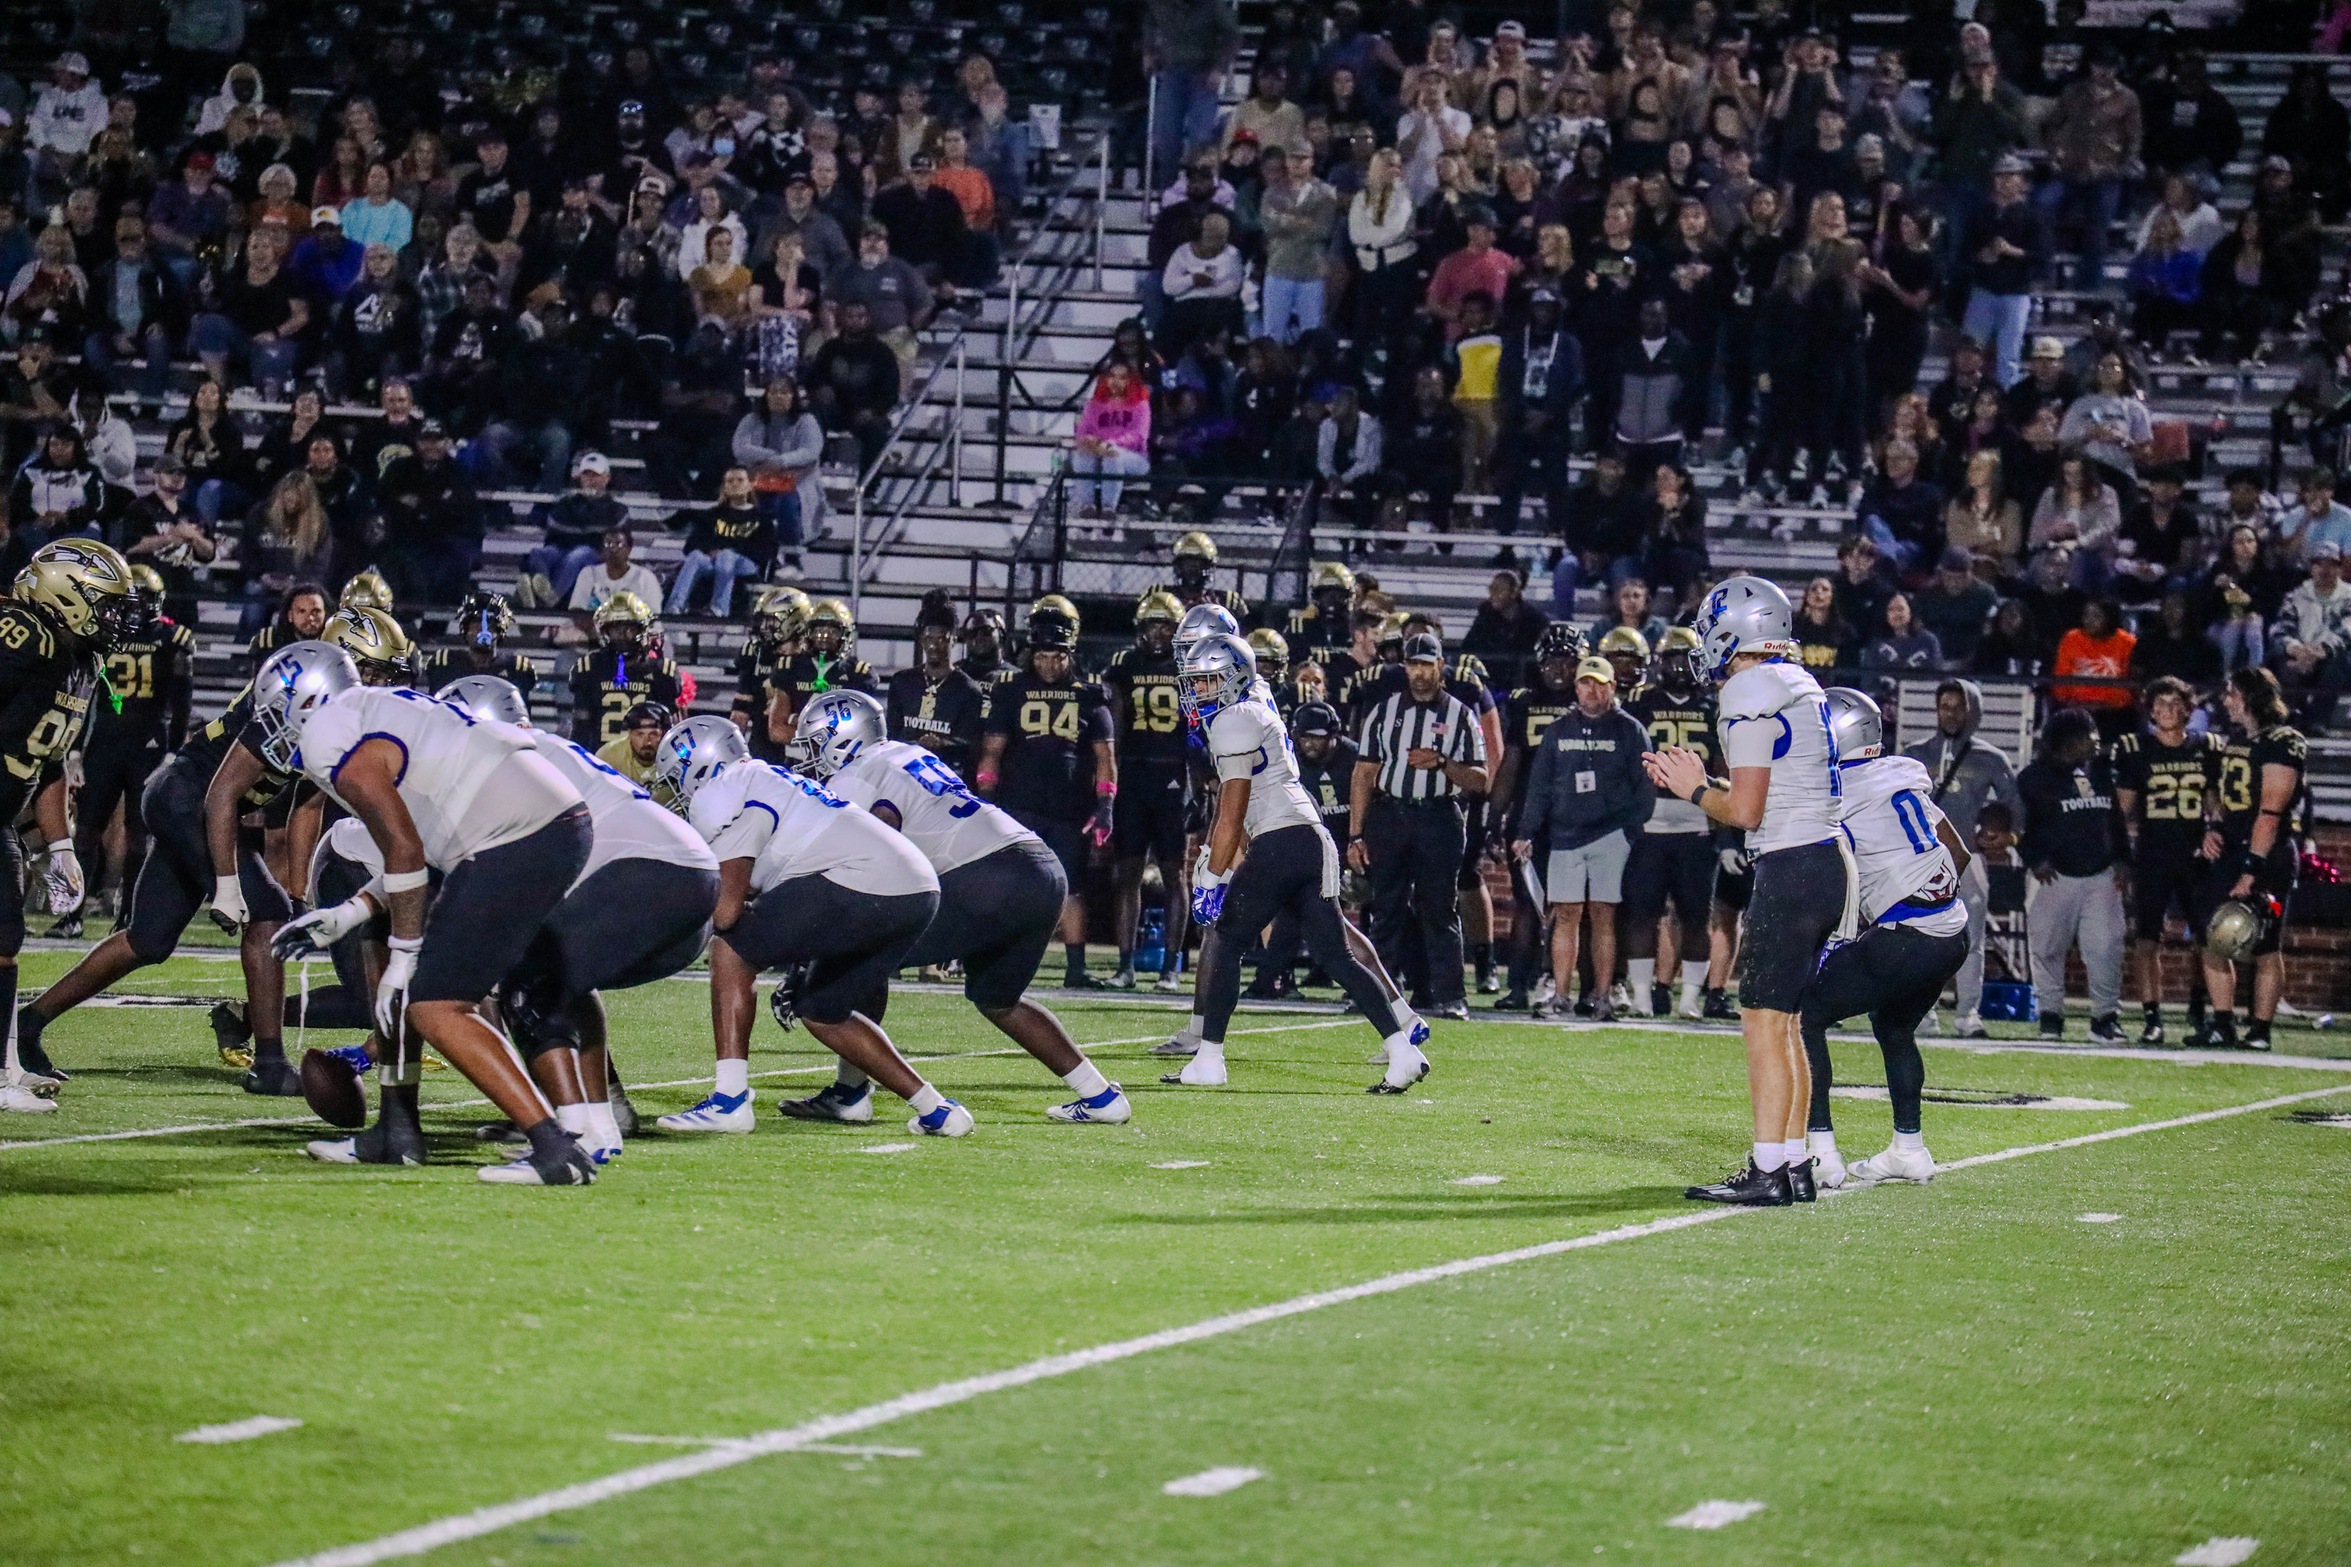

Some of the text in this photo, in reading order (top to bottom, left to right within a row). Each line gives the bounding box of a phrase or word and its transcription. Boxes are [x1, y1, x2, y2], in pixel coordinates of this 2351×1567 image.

[105, 653, 153, 698] 31
[270, 654, 303, 687] 75
[1026, 691, 1076, 700] WARRIORS
[1132, 686, 1179, 733] 19
[1653, 710, 1705, 721] WARRIORS
[600, 693, 646, 742] 2
[1020, 701, 1080, 743] 94
[2147, 773, 2207, 820] 26
